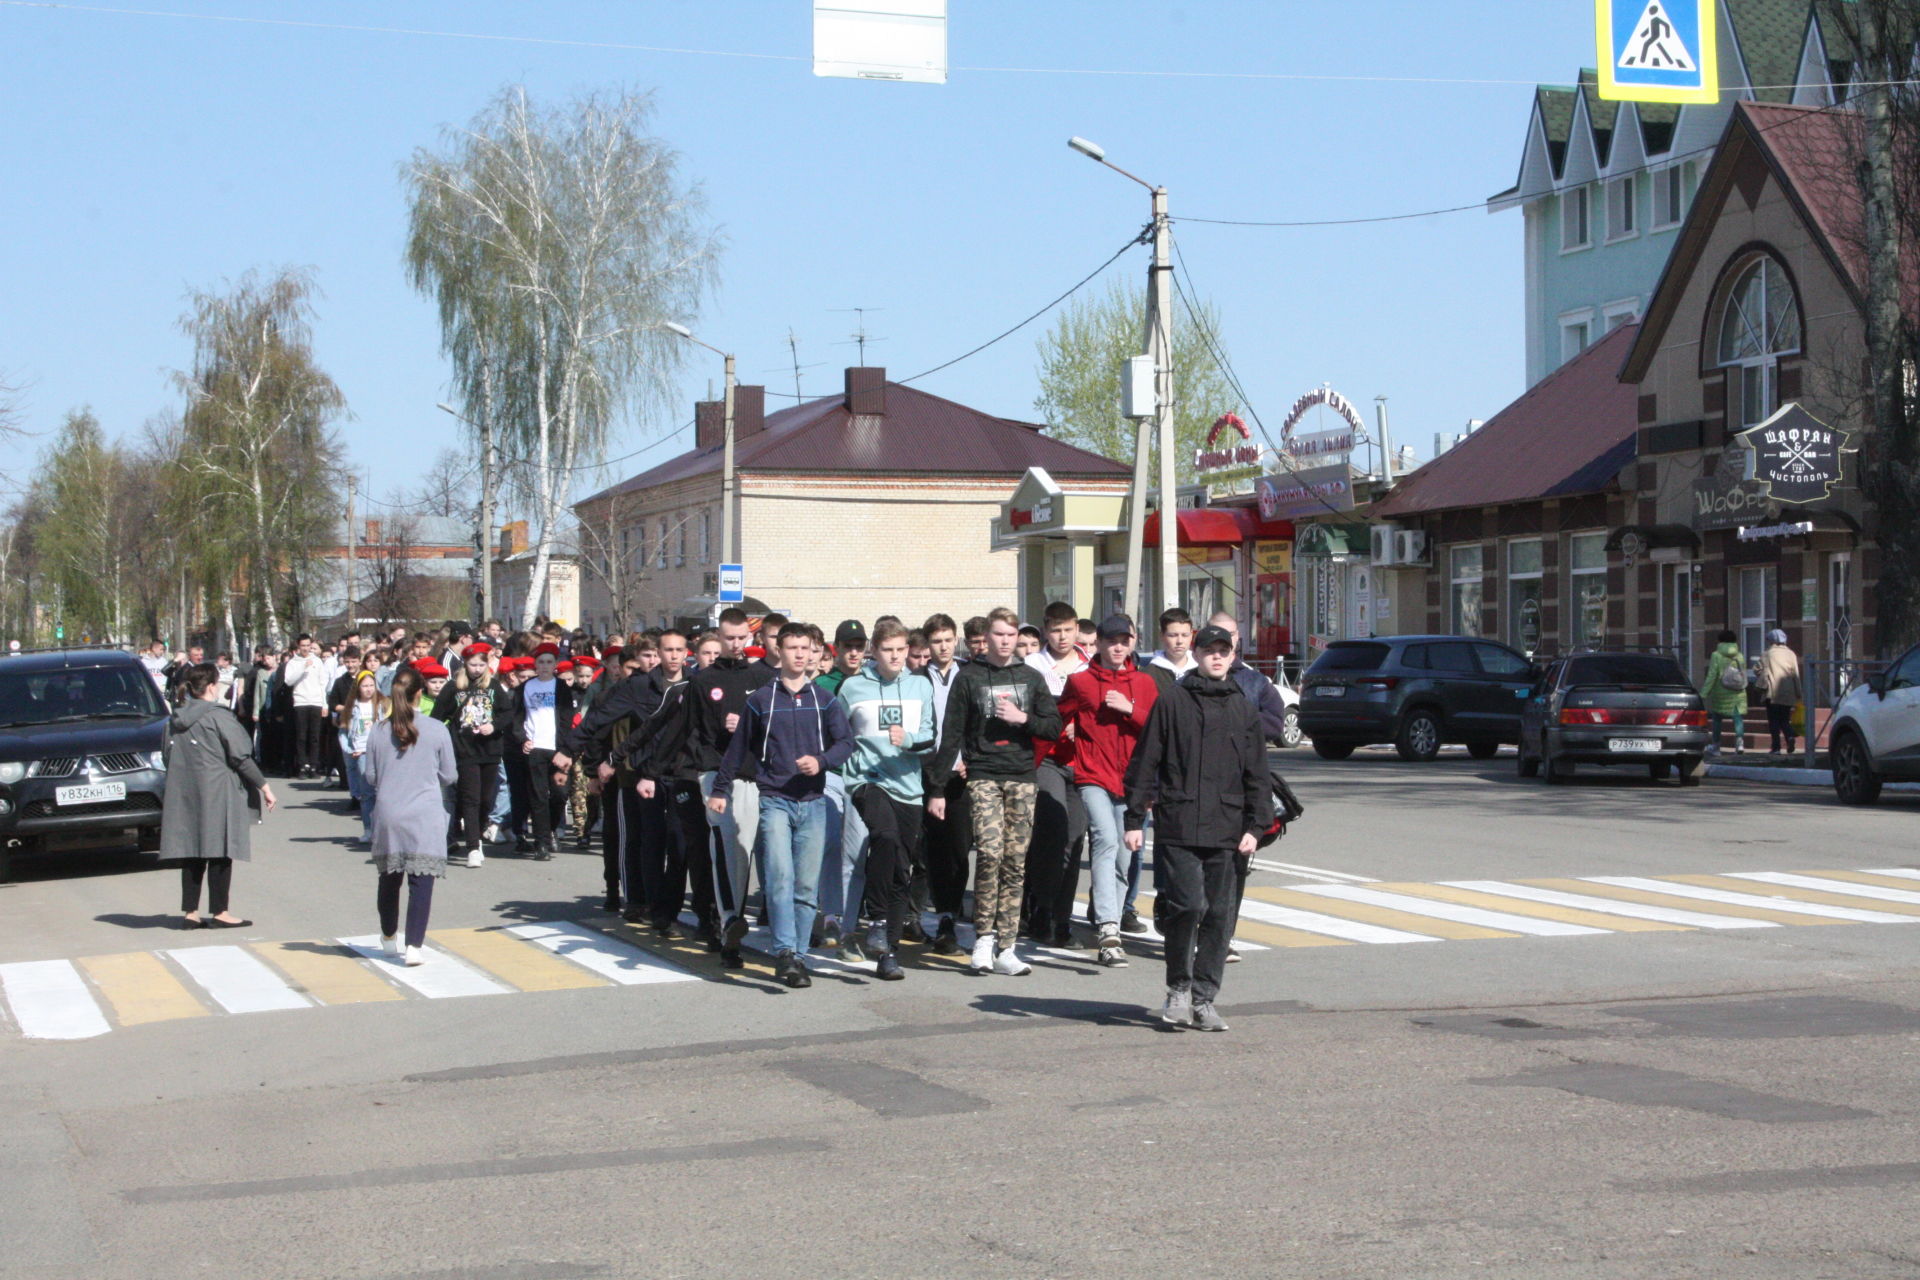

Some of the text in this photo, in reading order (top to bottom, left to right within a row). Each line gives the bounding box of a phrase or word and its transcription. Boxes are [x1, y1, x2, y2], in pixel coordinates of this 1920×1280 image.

[1281, 388, 1326, 441] СВАДЕБНЫЙ
[1329, 390, 1360, 433] САЛОН
[1764, 428, 1831, 444] ШАФРАН
[880, 707, 901, 724] KB
[61, 784, 122, 800] У832КН 116
